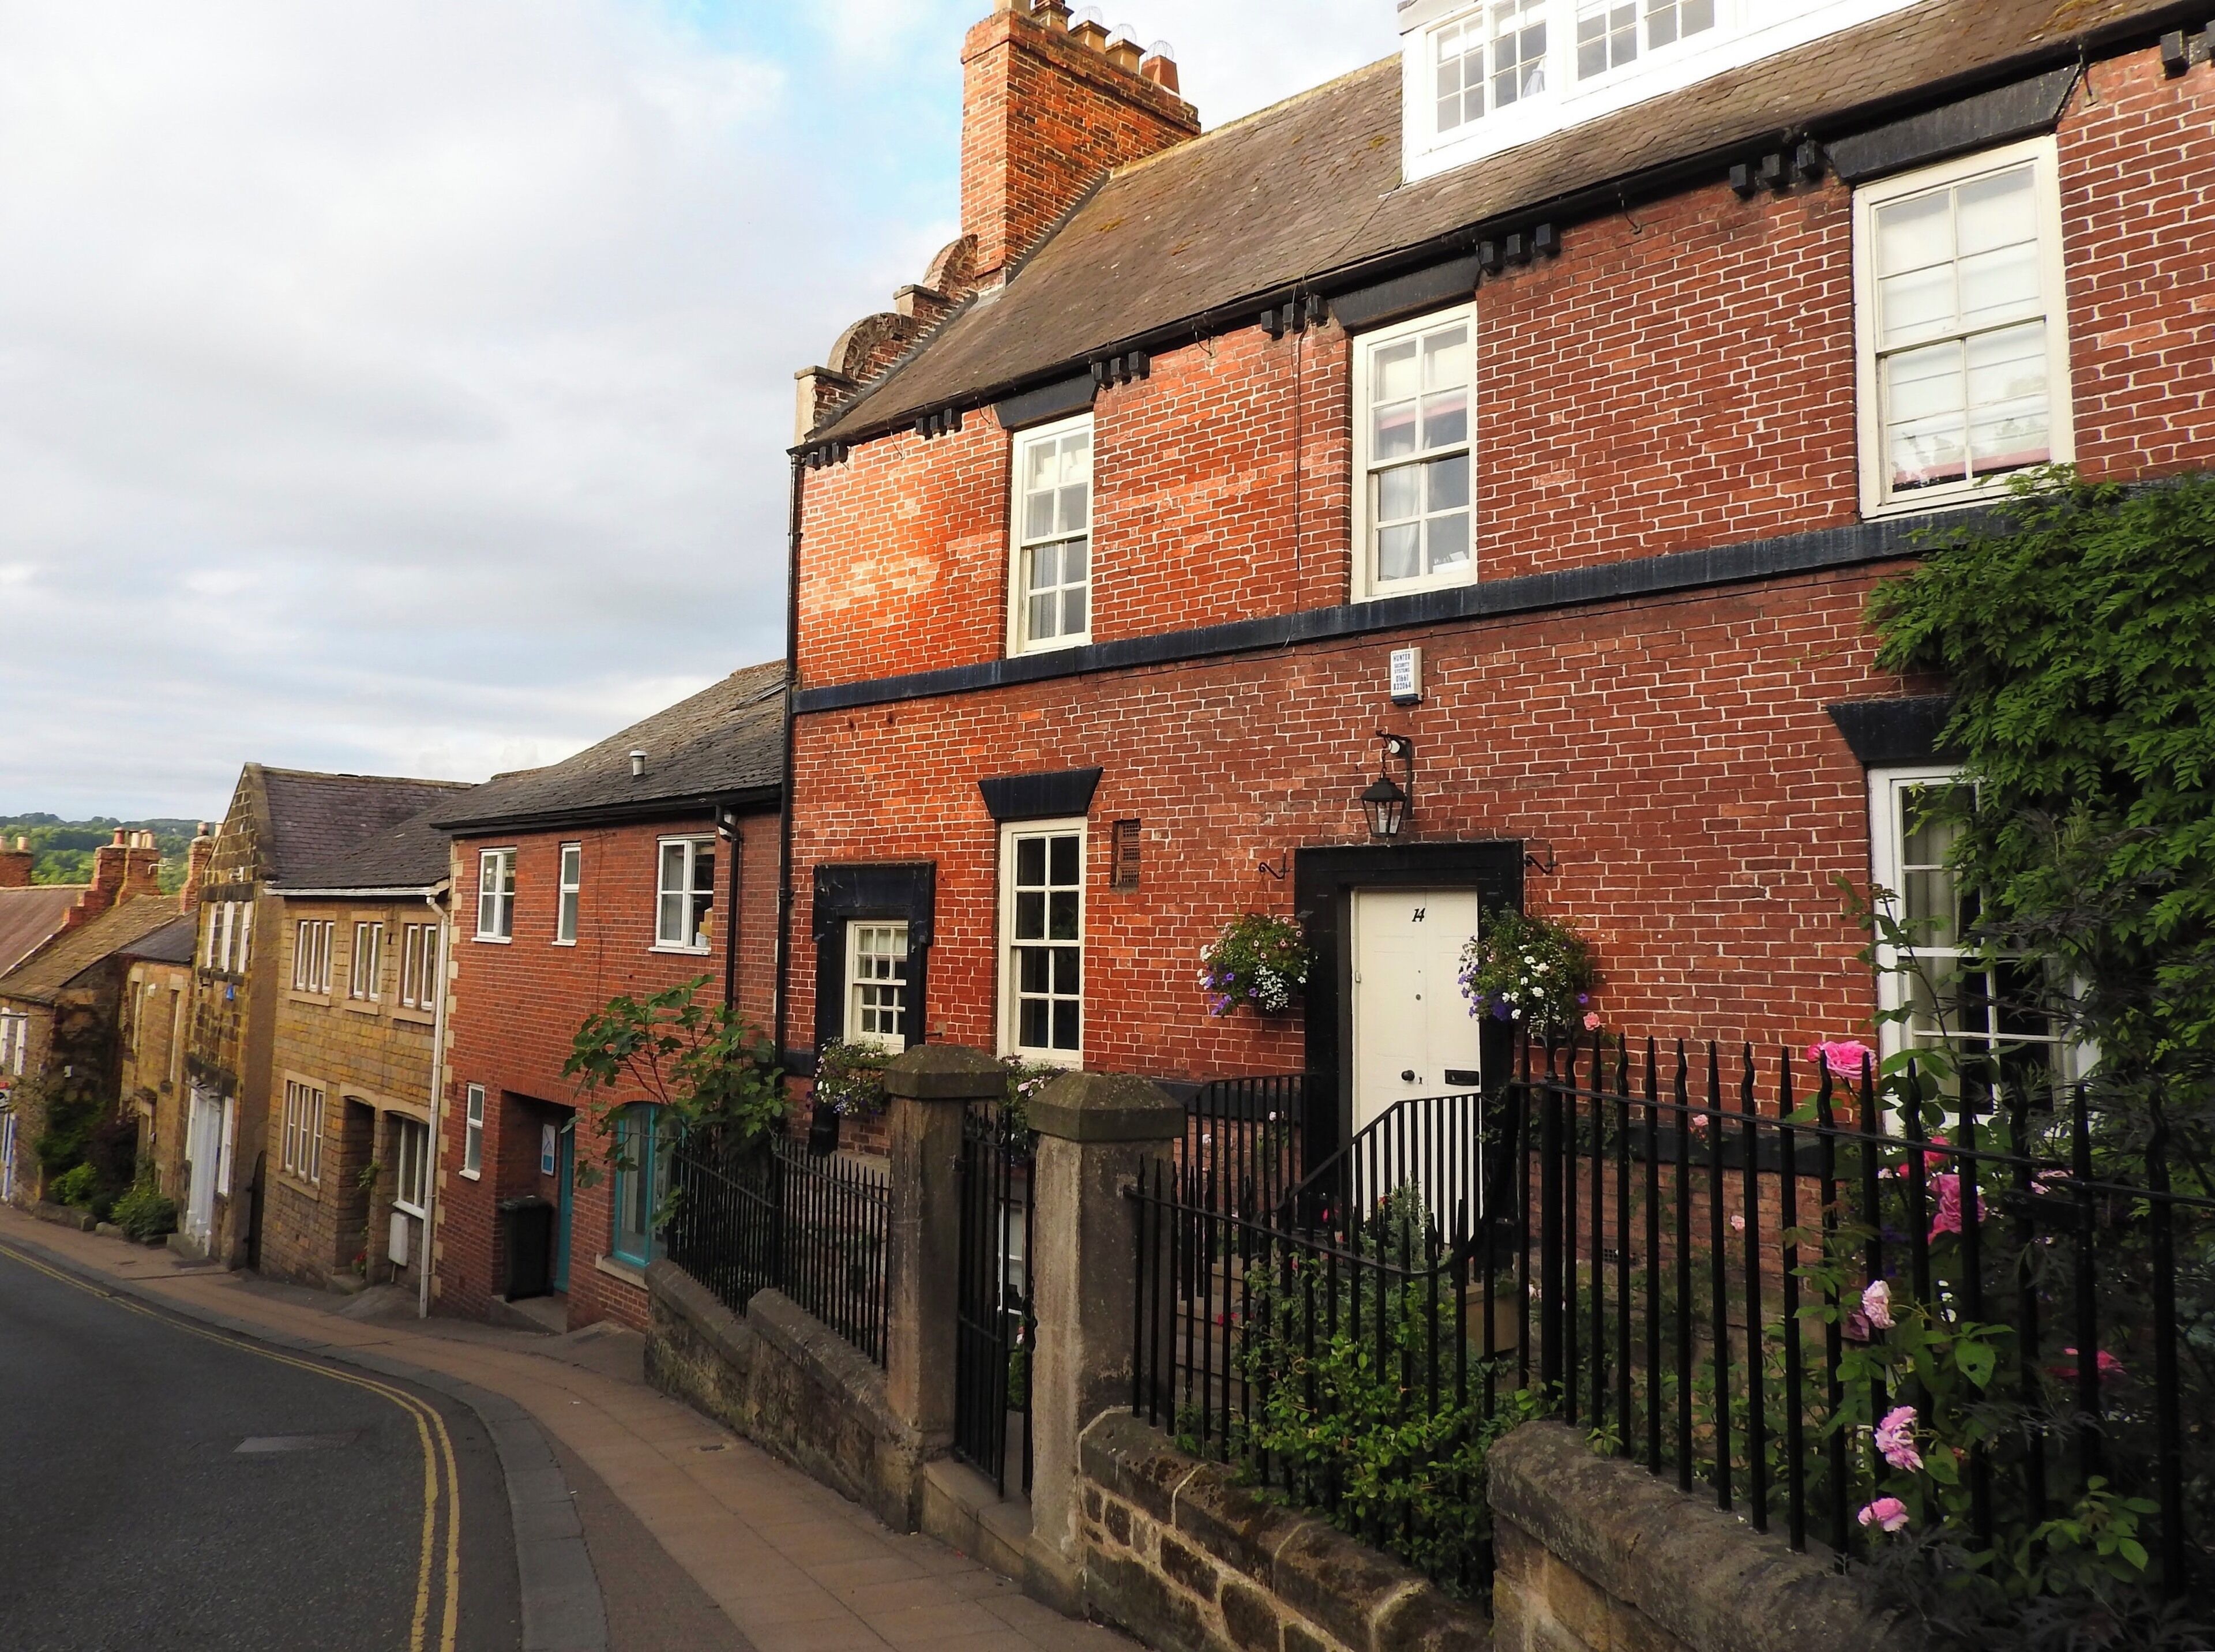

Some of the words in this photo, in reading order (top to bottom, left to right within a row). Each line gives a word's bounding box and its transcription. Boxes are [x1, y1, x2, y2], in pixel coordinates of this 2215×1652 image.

[1393, 654, 1410, 662] HUNTER
[1396, 674, 1409, 682] 01661
[1411, 907, 1425, 922] 14
